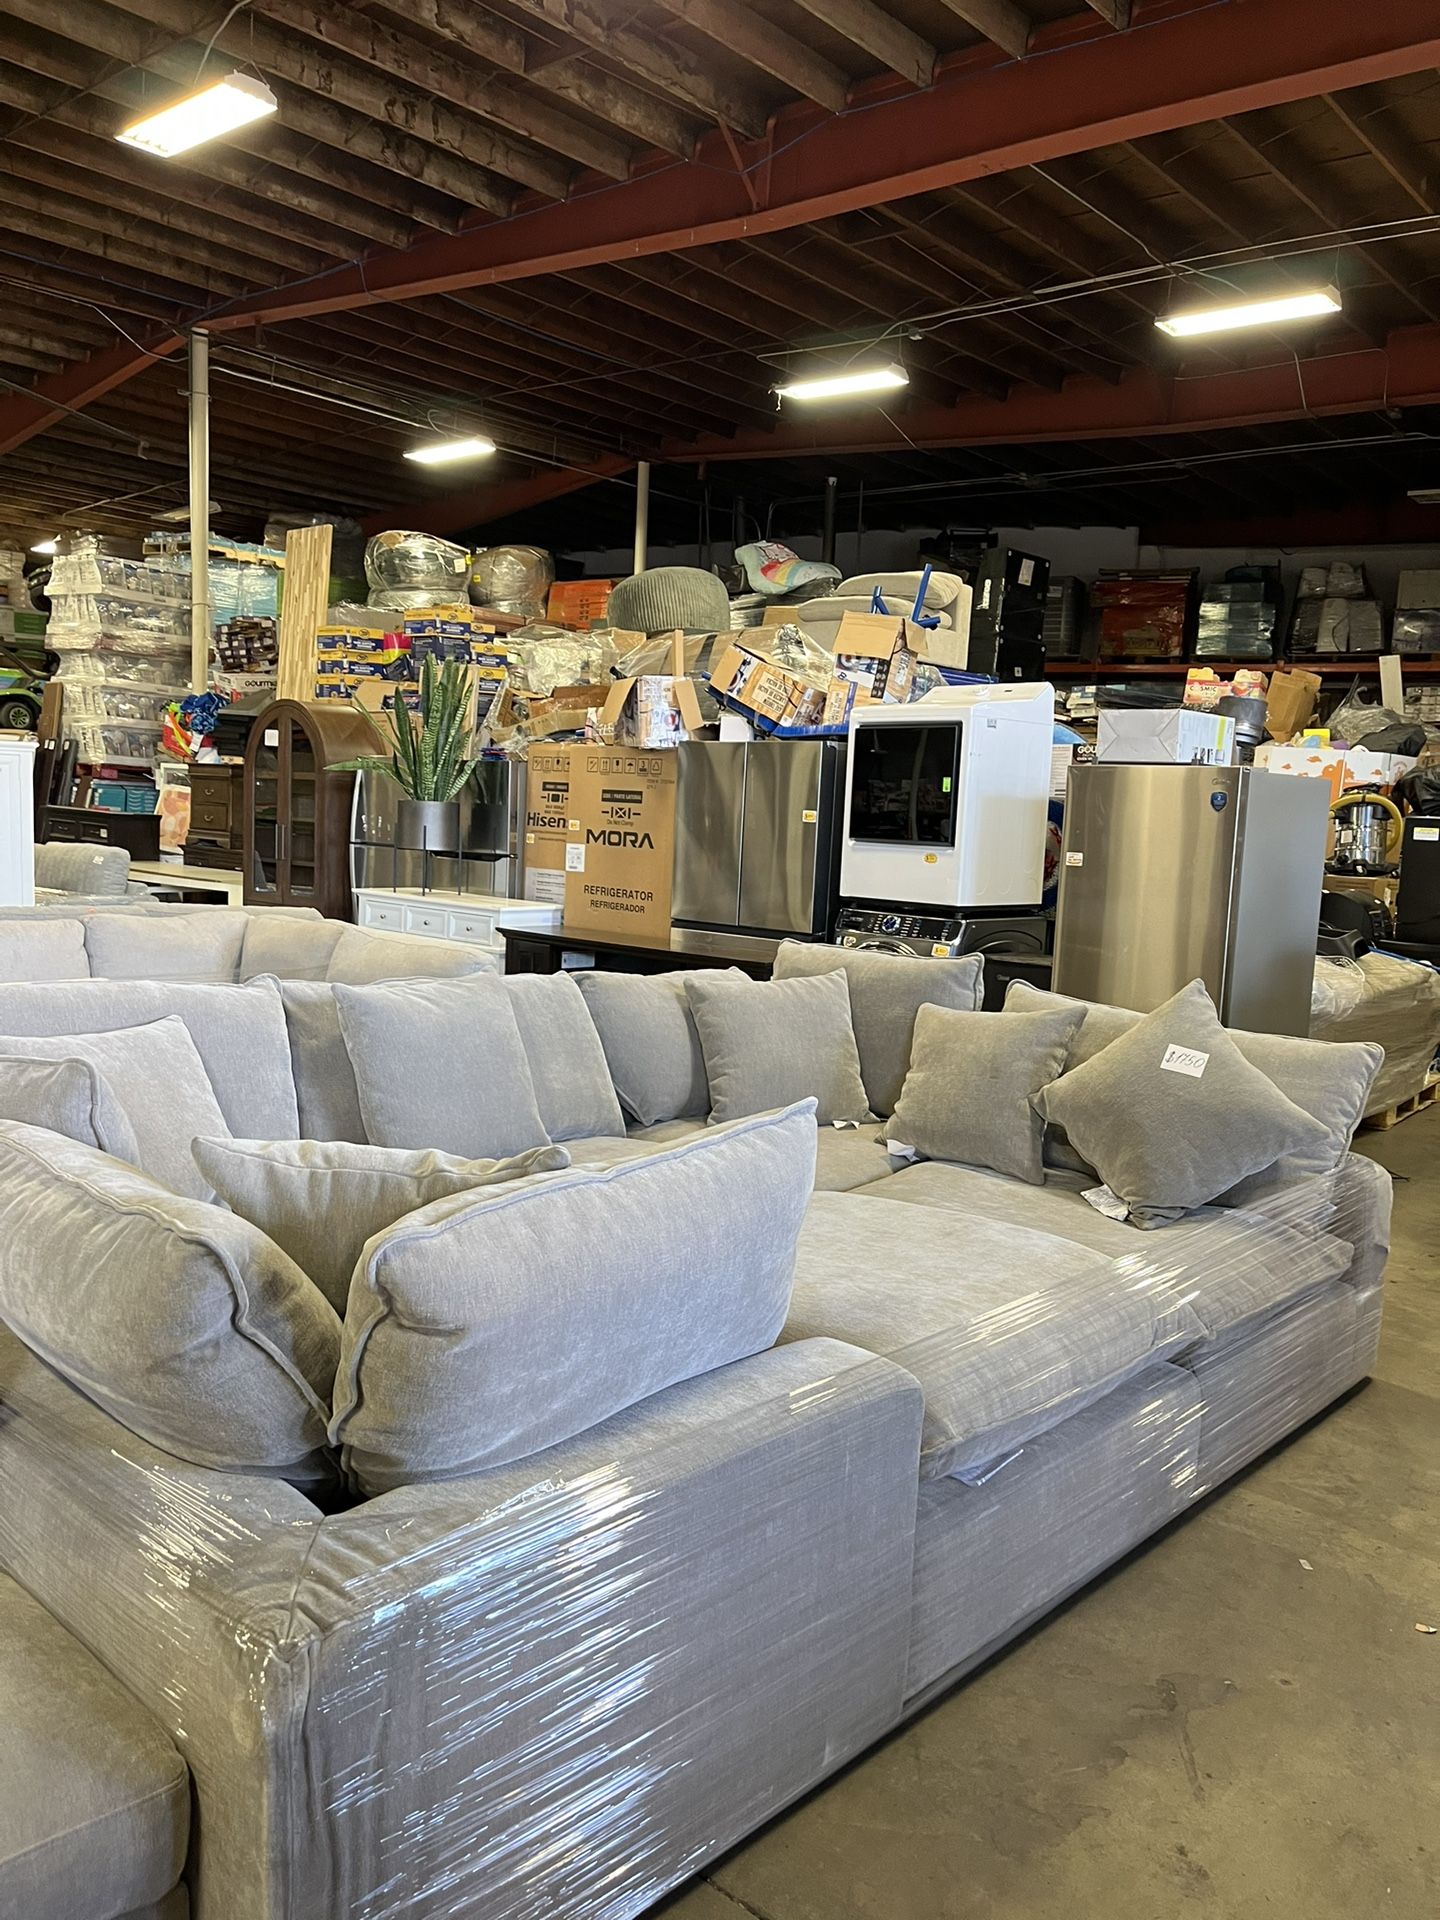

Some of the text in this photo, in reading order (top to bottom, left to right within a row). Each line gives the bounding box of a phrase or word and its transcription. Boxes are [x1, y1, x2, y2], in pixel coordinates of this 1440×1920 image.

[527, 812, 568, 829] Hisen
[586, 829, 654, 849] MORA
[583, 884, 654, 902] REFRIGERATOR
[590, 900, 645, 914] REFRIGERADOR
[1165, 1051, 1206, 1068] $1750
